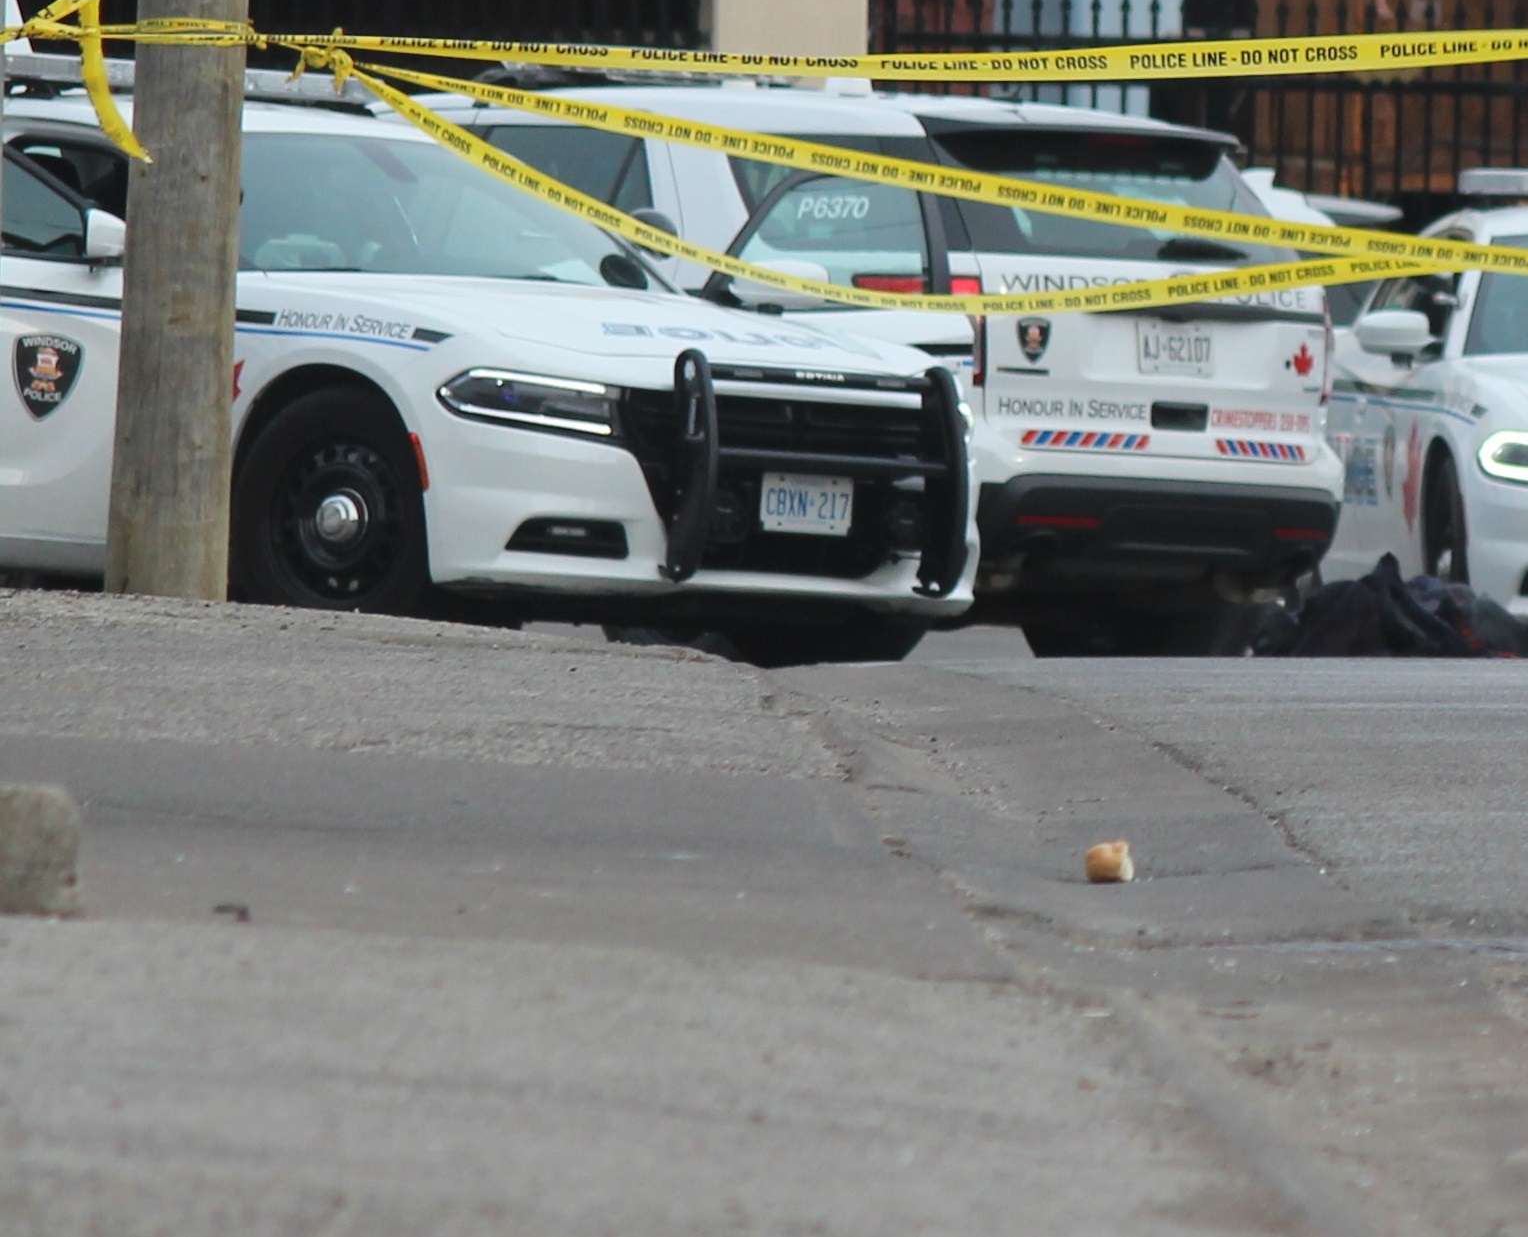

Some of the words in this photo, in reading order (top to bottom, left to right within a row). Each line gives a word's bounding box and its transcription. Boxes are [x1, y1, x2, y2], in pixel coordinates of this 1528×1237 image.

[1130, 53, 1187, 69] POLICE
[1192, 51, 1227, 66] LINE
[1240, 50, 1262, 64] DO
[1268, 48, 1300, 63] NOT
[1304, 45, 1358, 61] CROSS
[1380, 42, 1437, 58] POLICE
[1442, 41, 1478, 53] LINE
[990, 59, 1012, 70] DO
[1018, 58, 1049, 70] NOT
[1054, 56, 1108, 69] CROSS
[624, 116, 663, 133] CROSS
[667, 124, 691, 139] NOT
[442, 128, 472, 155] CROSS
[694, 129, 712, 143] DO
[722, 134, 748, 151] LINE
[752, 140, 795, 160] POLICE
[810, 152, 850, 170] CROSS
[854, 159, 879, 175] NOT
[882, 165, 899, 178] DO
[908, 169, 935, 185] LINE
[482, 153, 516, 178] POLICE
[519, 172, 540, 193] LINE
[547, 187, 561, 202] DO
[564, 195, 585, 212] NOT
[587, 202, 621, 228] CROSS
[938, 174, 981, 194] POLICE
[997, 185, 1037, 203] CROSS
[1040, 192, 1065, 207] NOT
[798, 195, 869, 220] P6370
[1068, 197, 1085, 210] DO
[1094, 201, 1121, 215] LINE
[1124, 205, 1167, 223] POLICE
[1182, 215, 1222, 233] CROSS
[1225, 221, 1250, 236] NOT
[1254, 226, 1271, 239] DO
[1279, 228, 1306, 243] LINE
[1308, 232, 1352, 248] POLICE
[1349, 260, 1392, 273] POLICE
[1167, 281, 1210, 297] POLICE
[1214, 277, 1240, 291] LINE
[1249, 274, 1266, 286] DO
[1268, 270, 1292, 284] NOT
[1295, 265, 1335, 280] CROSS
[982, 301, 1025, 310] POLICE
[1028, 299, 1055, 309] LINE
[1064, 297, 1082, 308] DO
[1084, 294, 1108, 306] NOT
[1112, 288, 1151, 304] CROSS
[1216, 289, 1306, 310] OLICE
[278, 310, 330, 330] HONOUR
[334, 313, 349, 330] IN
[350, 314, 411, 339] SERVICE
[22, 335, 78, 355] WINDSOR
[23, 387, 62, 404] POLICE
[999, 397, 1063, 418] HONOUR
[1069, 400, 1084, 419] IN
[1088, 399, 1148, 420] SERVICE
